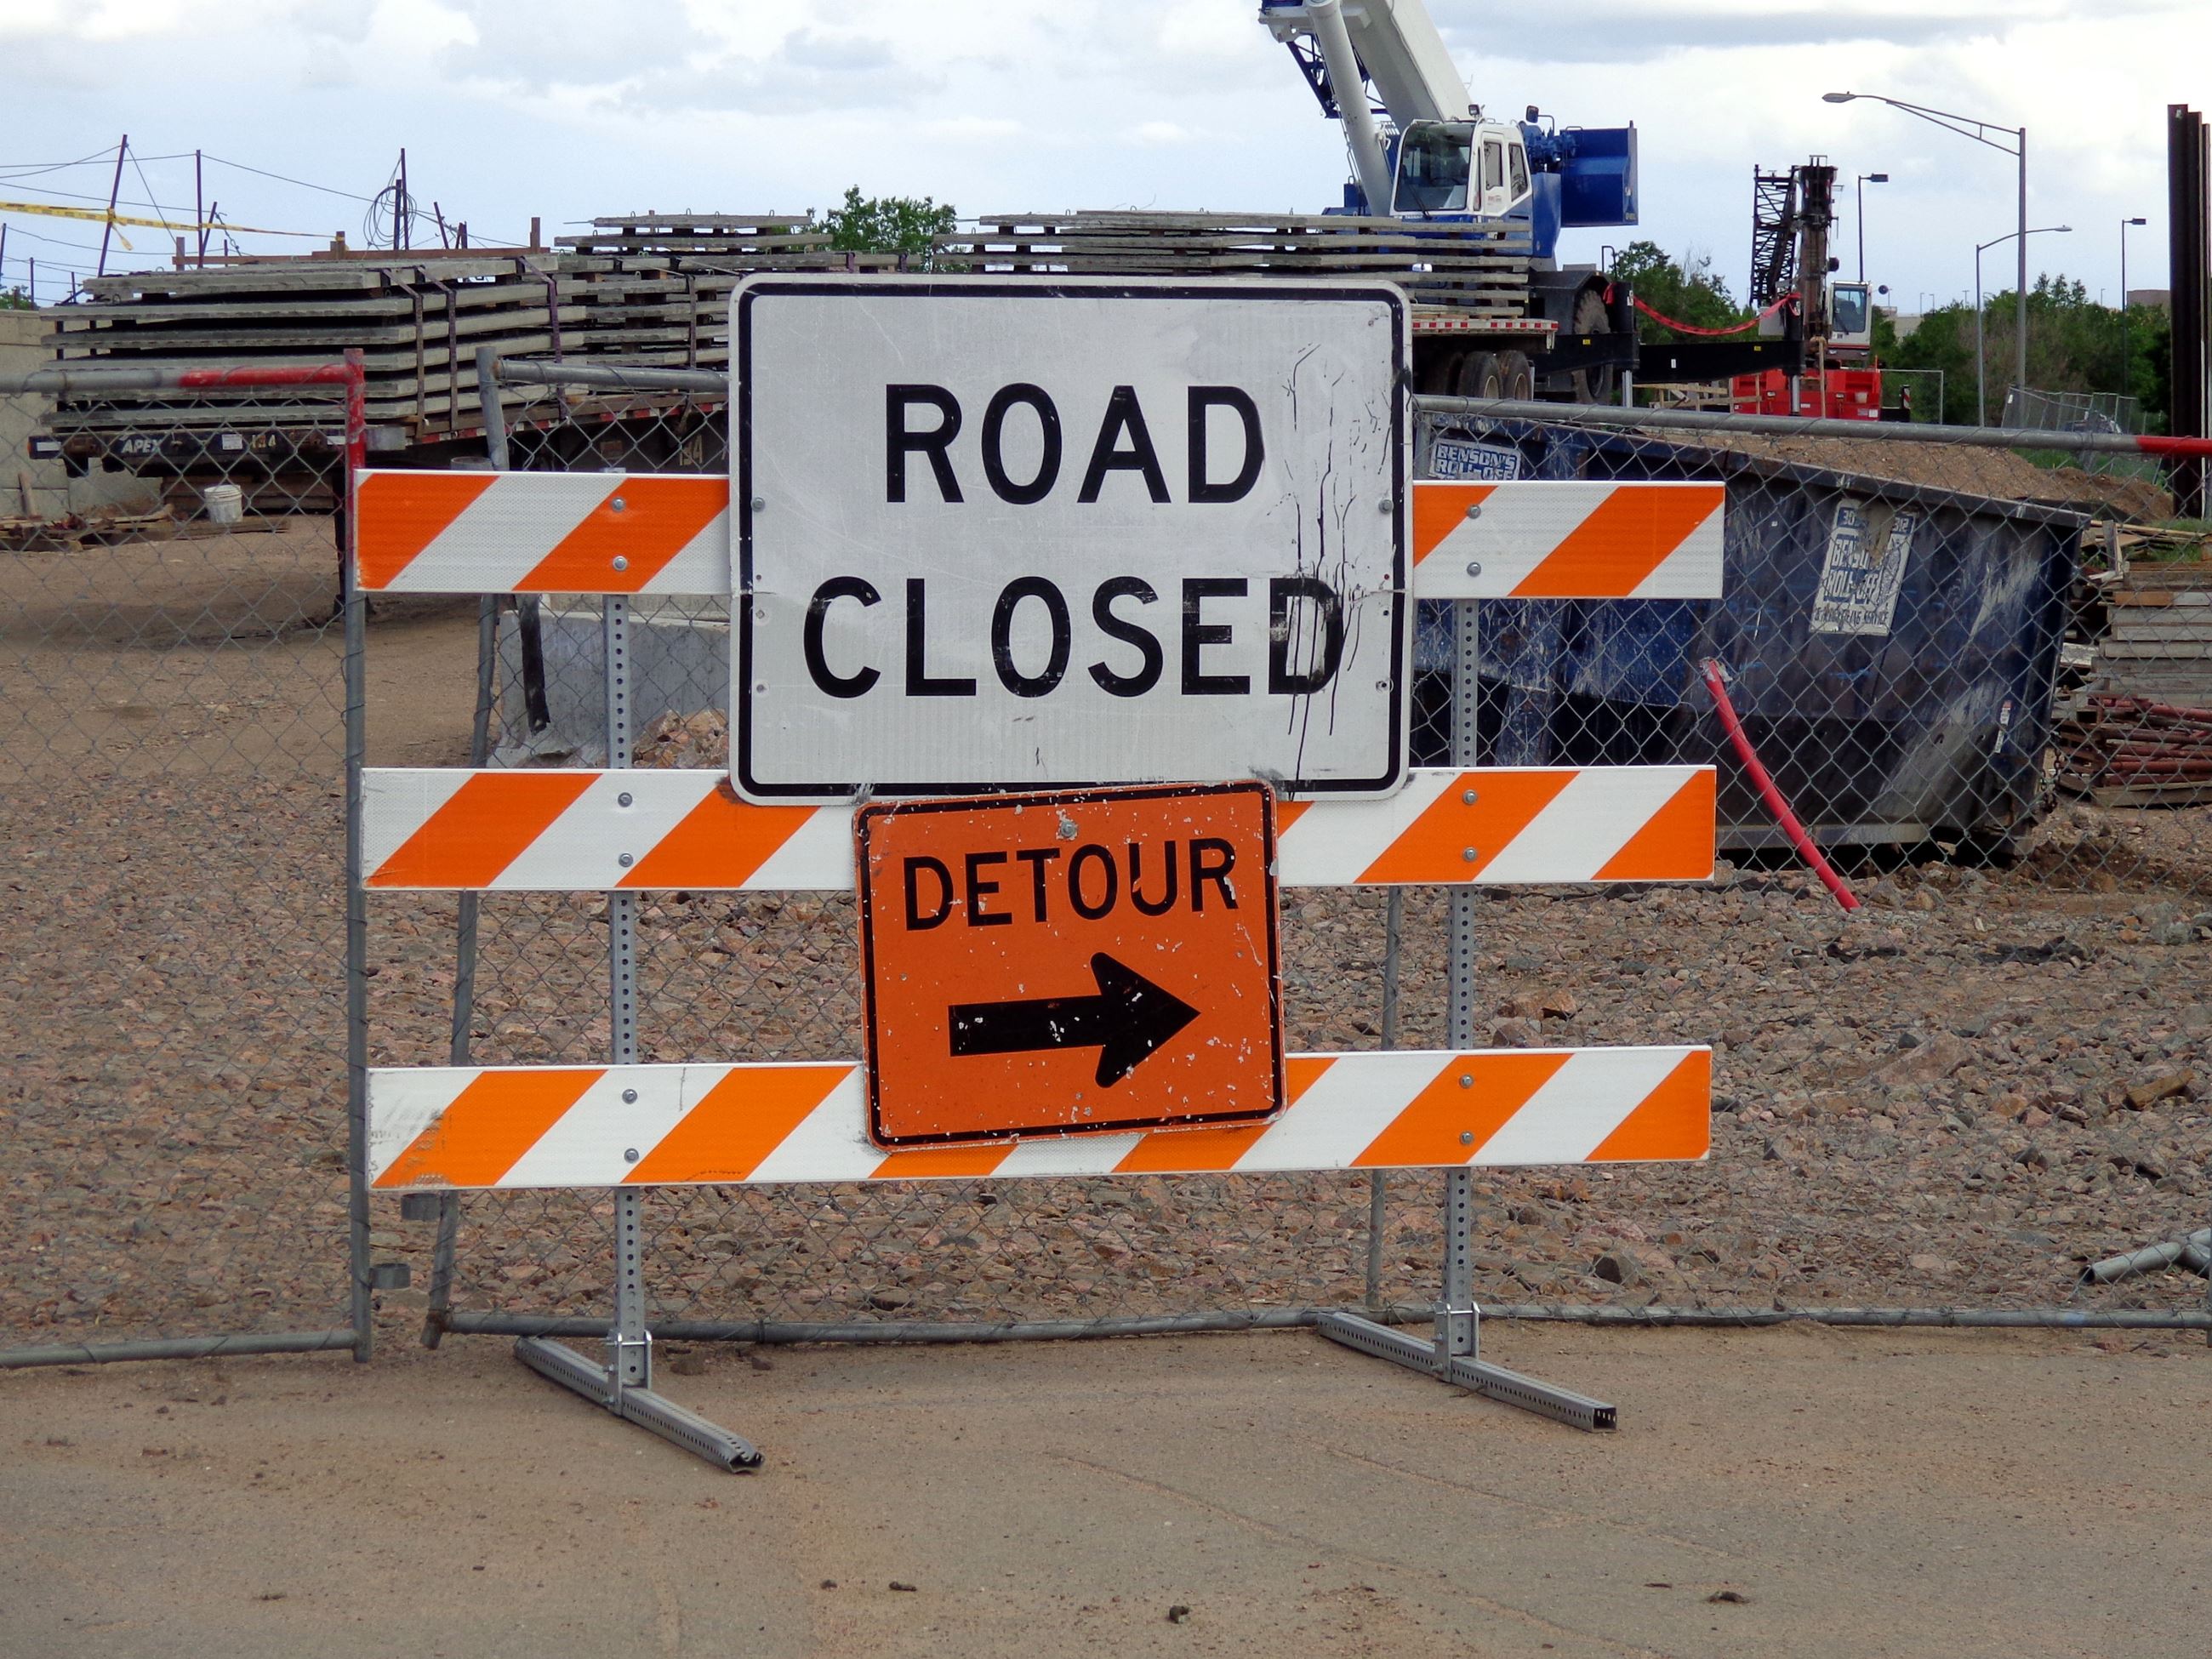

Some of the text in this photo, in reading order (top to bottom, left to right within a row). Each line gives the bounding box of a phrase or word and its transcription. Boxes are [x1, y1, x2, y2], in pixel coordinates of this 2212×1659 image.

[121, 438, 162, 453] APEX
[885, 381, 1266, 505] ROAD
[1437, 445, 1516, 469] BENSON'S
[802, 575, 1343, 699] CLOSED
[903, 836, 1240, 932] DETOUR
